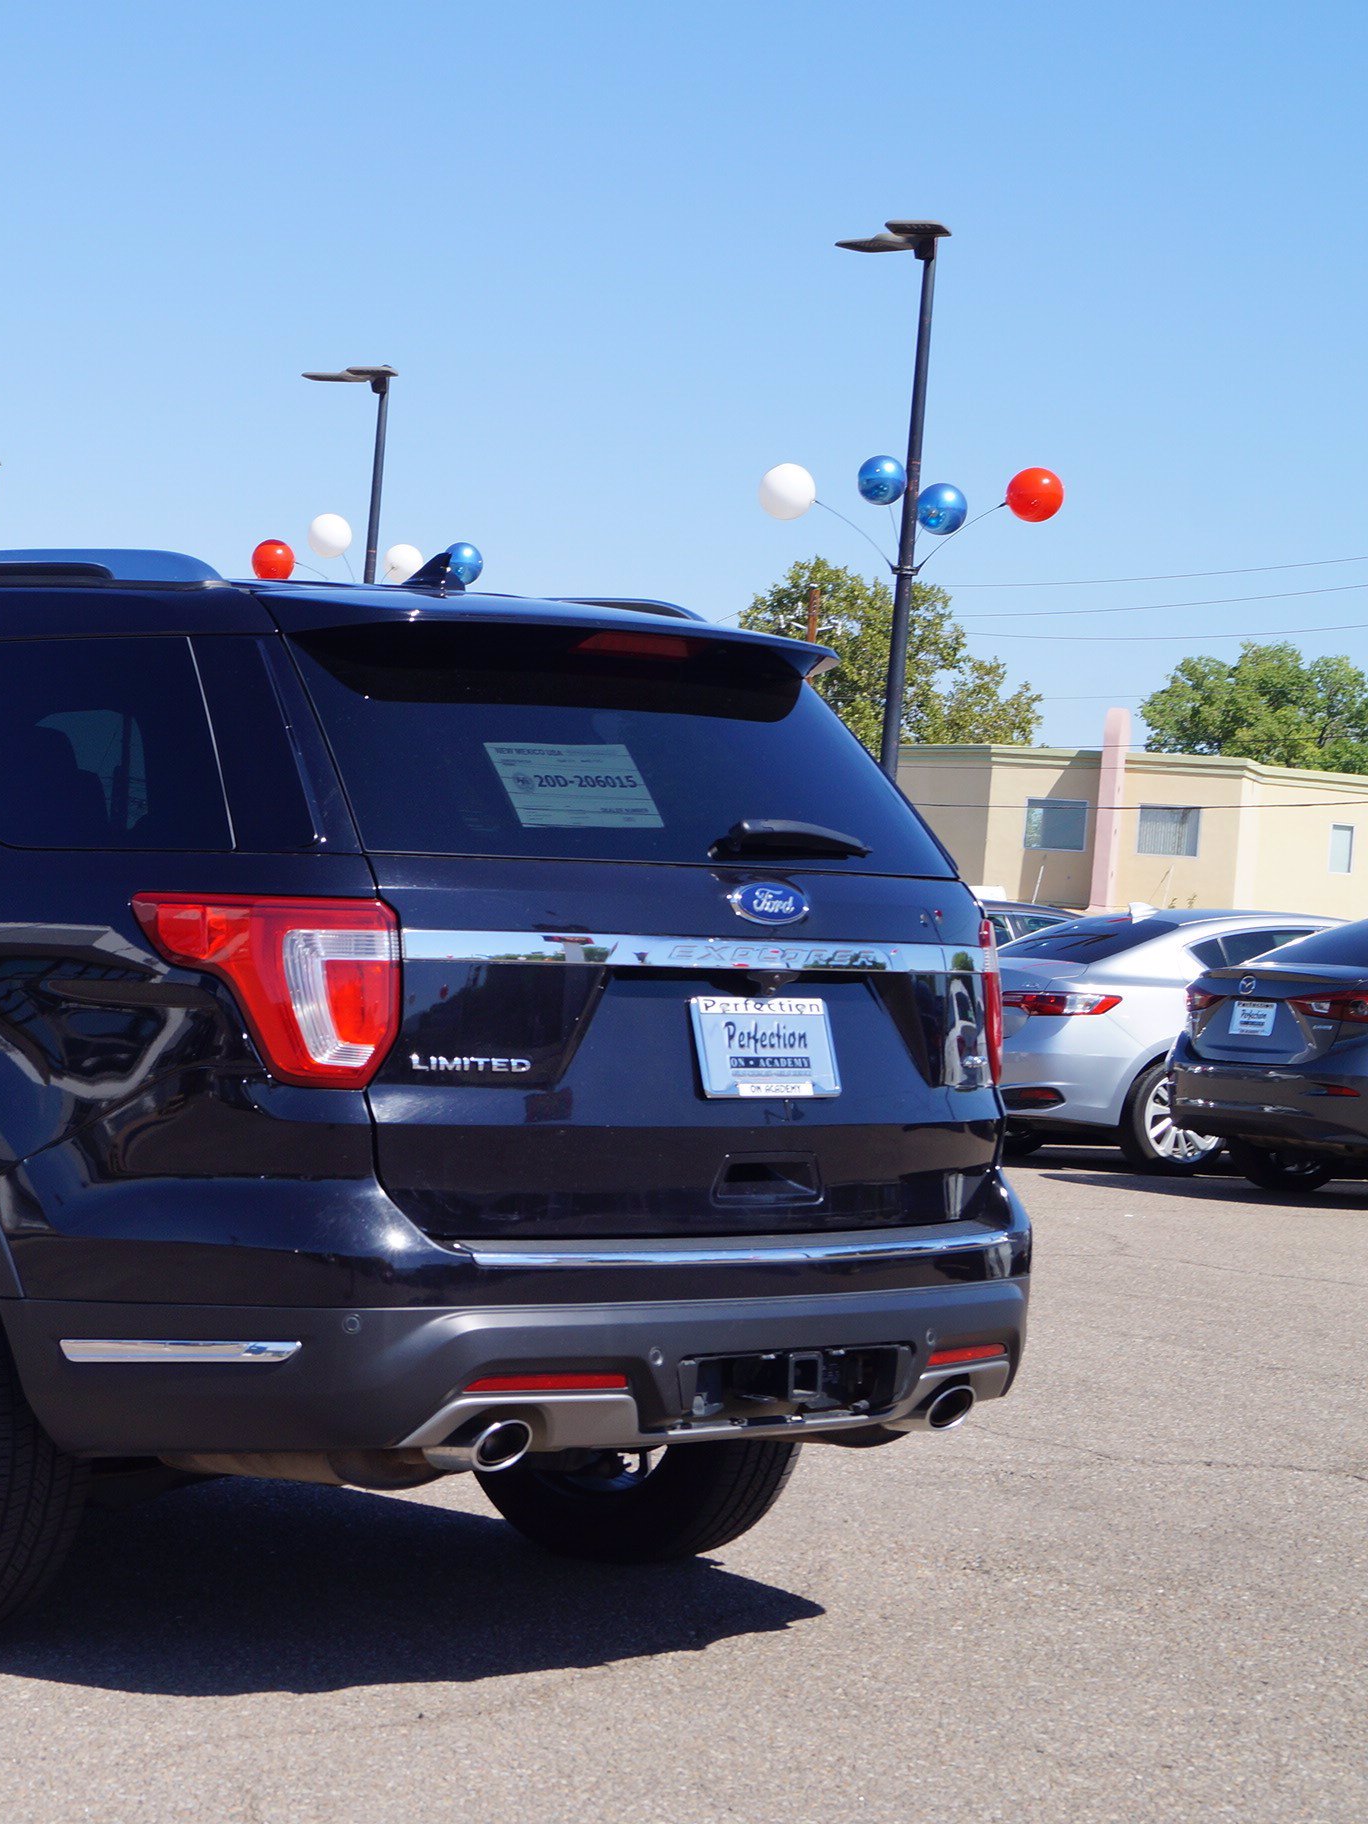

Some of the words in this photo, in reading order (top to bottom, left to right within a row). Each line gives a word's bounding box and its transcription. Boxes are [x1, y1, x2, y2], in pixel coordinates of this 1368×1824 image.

[534, 774, 638, 789] 20D-206015
[752, 887, 795, 914] Ford
[668, 944, 876, 966] EXPLORER
[704, 998, 821, 1014] Perfection
[724, 1021, 808, 1054] Perfection
[410, 1052, 532, 1073] LIMITED
[731, 1057, 745, 1068] ON
[759, 1057, 810, 1068] ACADEMY
